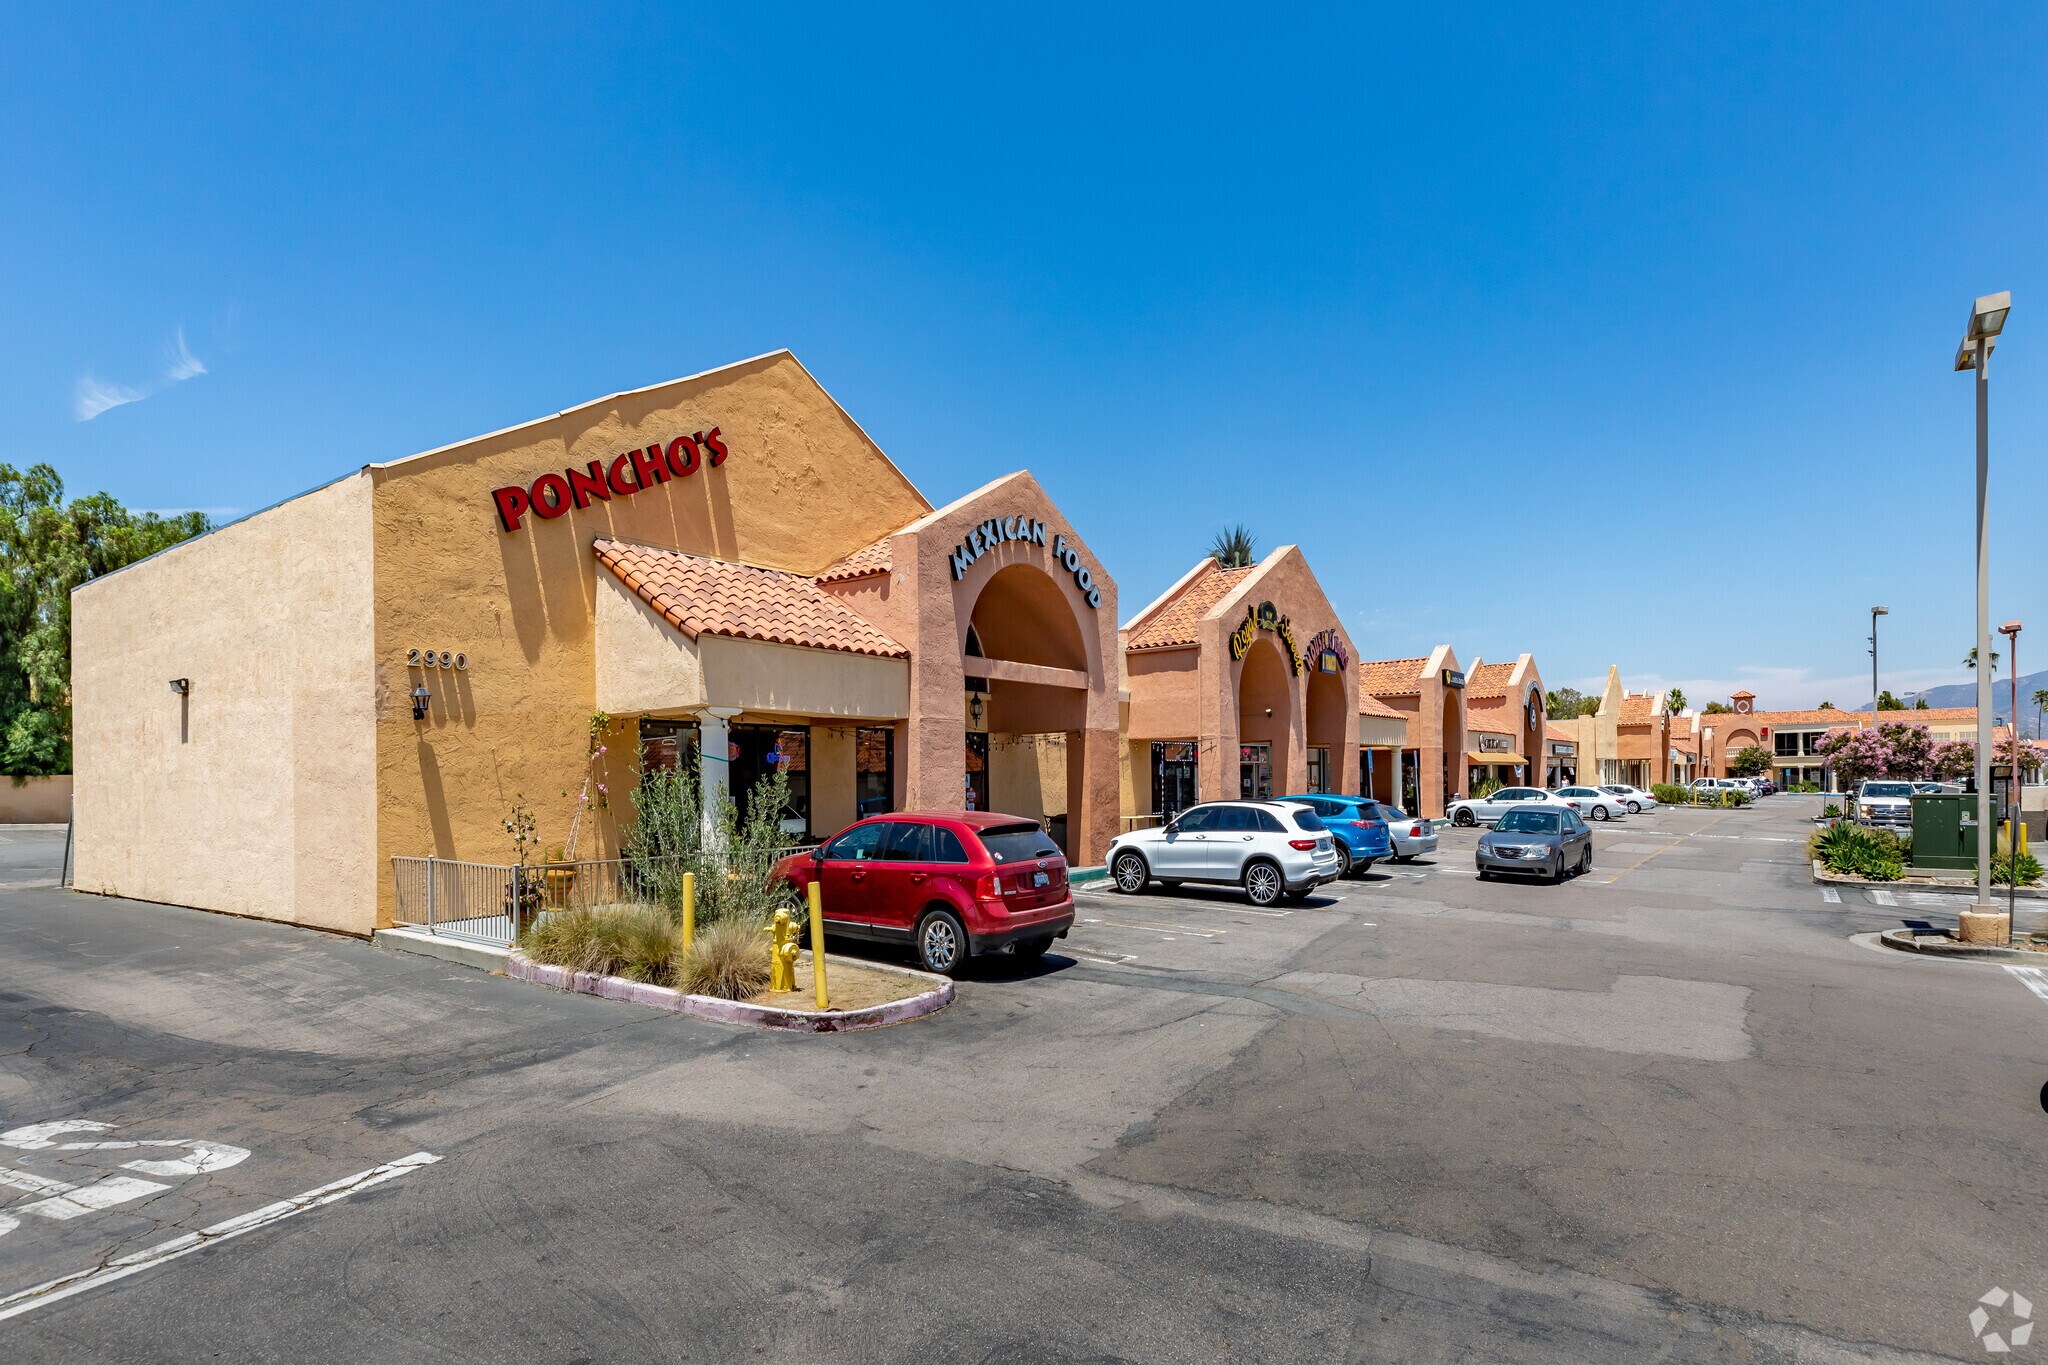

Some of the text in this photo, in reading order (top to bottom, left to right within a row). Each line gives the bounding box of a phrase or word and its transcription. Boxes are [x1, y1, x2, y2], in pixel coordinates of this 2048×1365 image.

[491, 426, 729, 533] PONCHO'S
[949, 514, 1102, 609] MEXICAN FOOD
[407, 649, 468, 671] 2990
[1231, 606, 1258, 660] Royal
